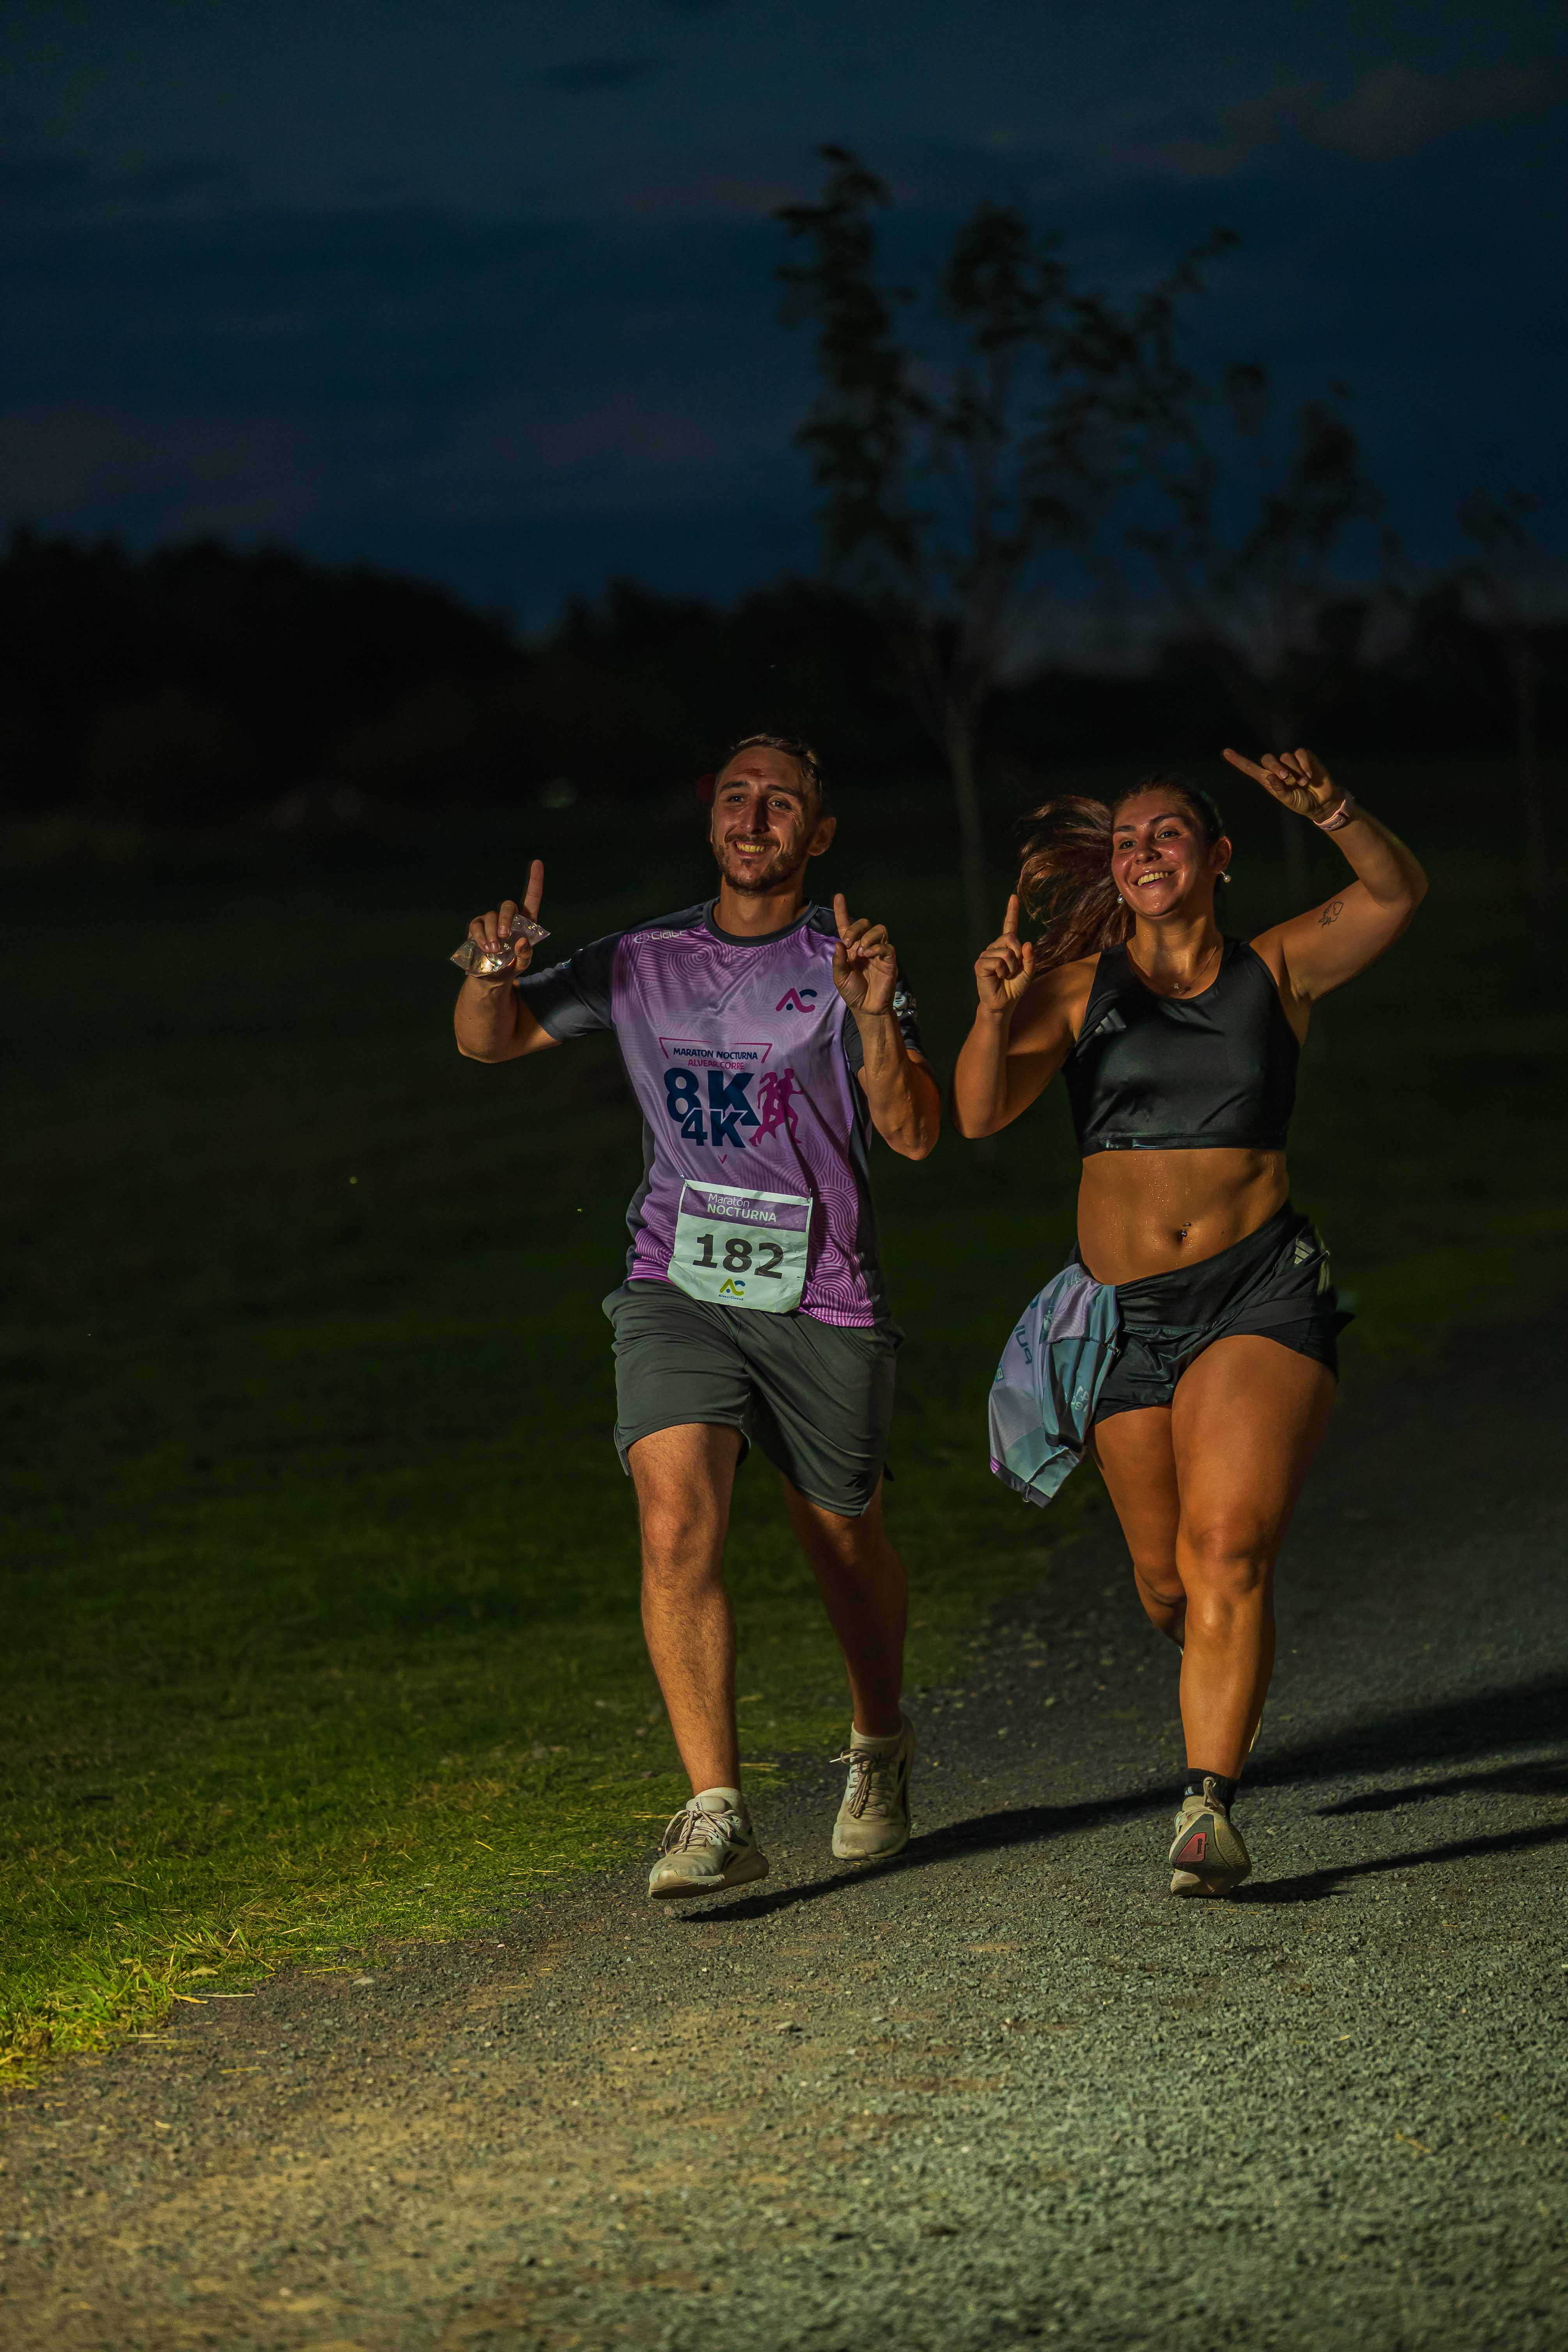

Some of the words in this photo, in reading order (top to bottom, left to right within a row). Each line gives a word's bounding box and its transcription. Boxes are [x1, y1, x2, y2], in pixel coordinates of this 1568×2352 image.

[673, 1048, 714, 1058] MARATON
[716, 1051, 758, 1060] NOCTURNA
[687, 1059, 718, 1068] ALVEAR
[720, 1062, 745, 1070] CORRE
[664, 1068, 762, 1126] 8K
[681, 1109, 747, 1148] 4K
[708, 1193, 749, 1208] Maratón
[707, 1203, 777, 1223] NOCTURNA
[692, 1233, 783, 1279] 182
